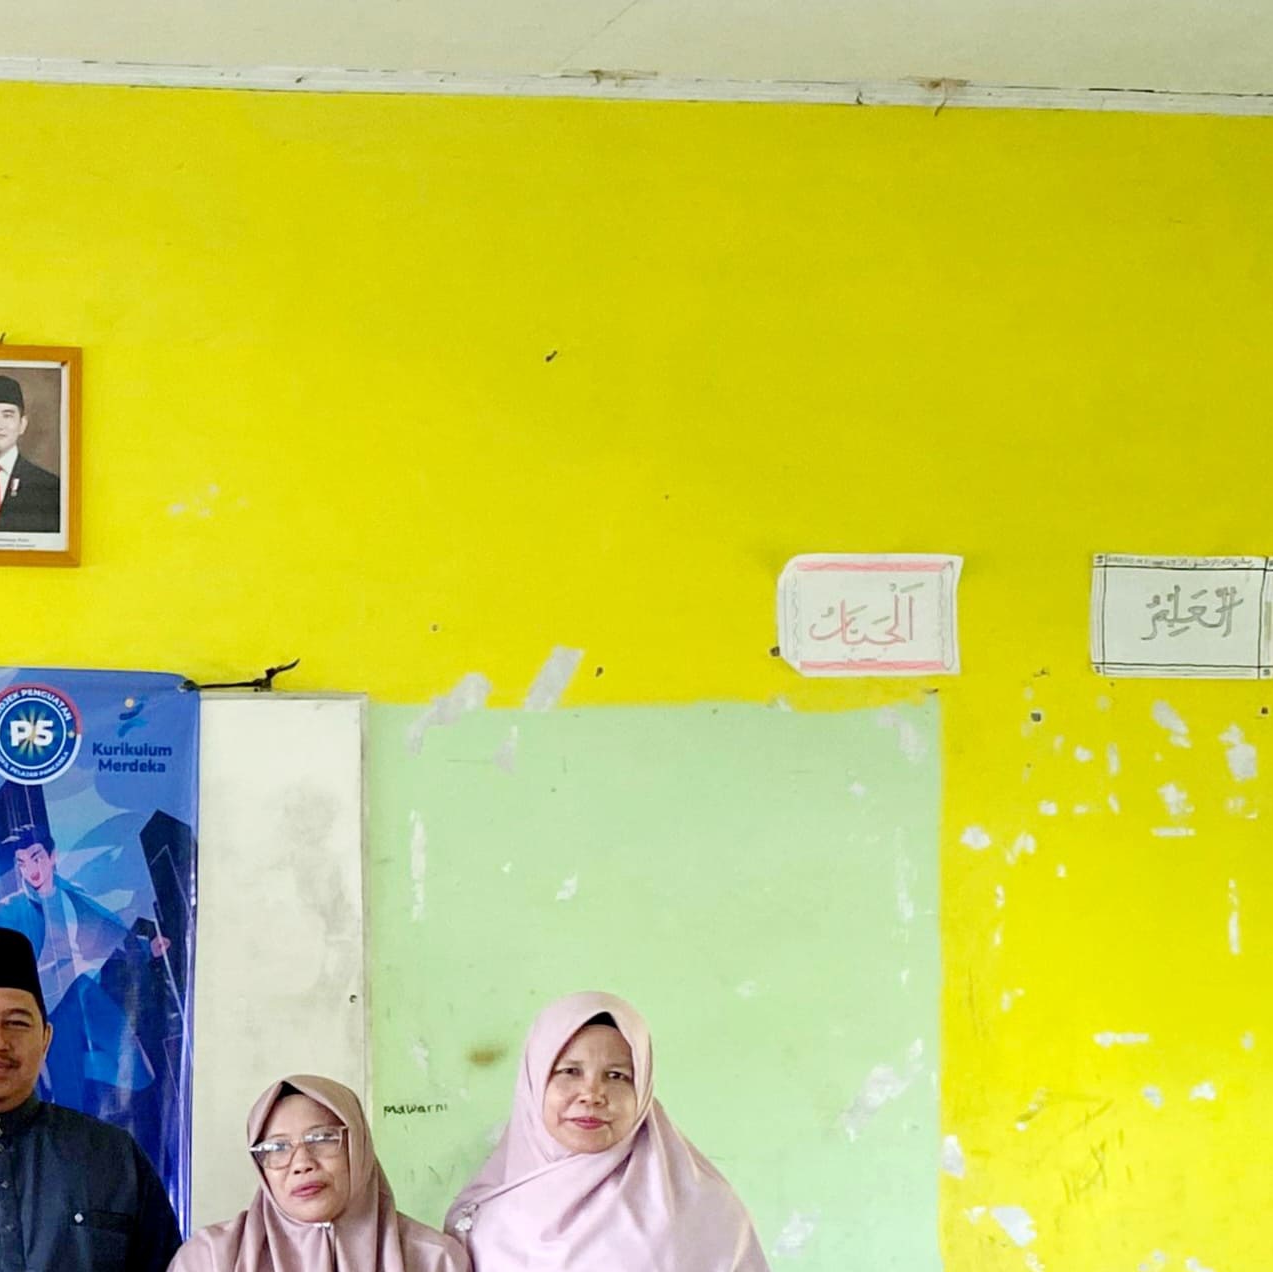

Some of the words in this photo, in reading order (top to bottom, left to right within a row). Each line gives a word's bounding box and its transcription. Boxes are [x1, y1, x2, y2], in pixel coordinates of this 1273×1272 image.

[20, 689, 73, 721] PENGUATAN
[10, 720, 54, 747] P5
[92, 742, 173, 757] Kurikulum
[98, 760, 167, 773] Merdeka
